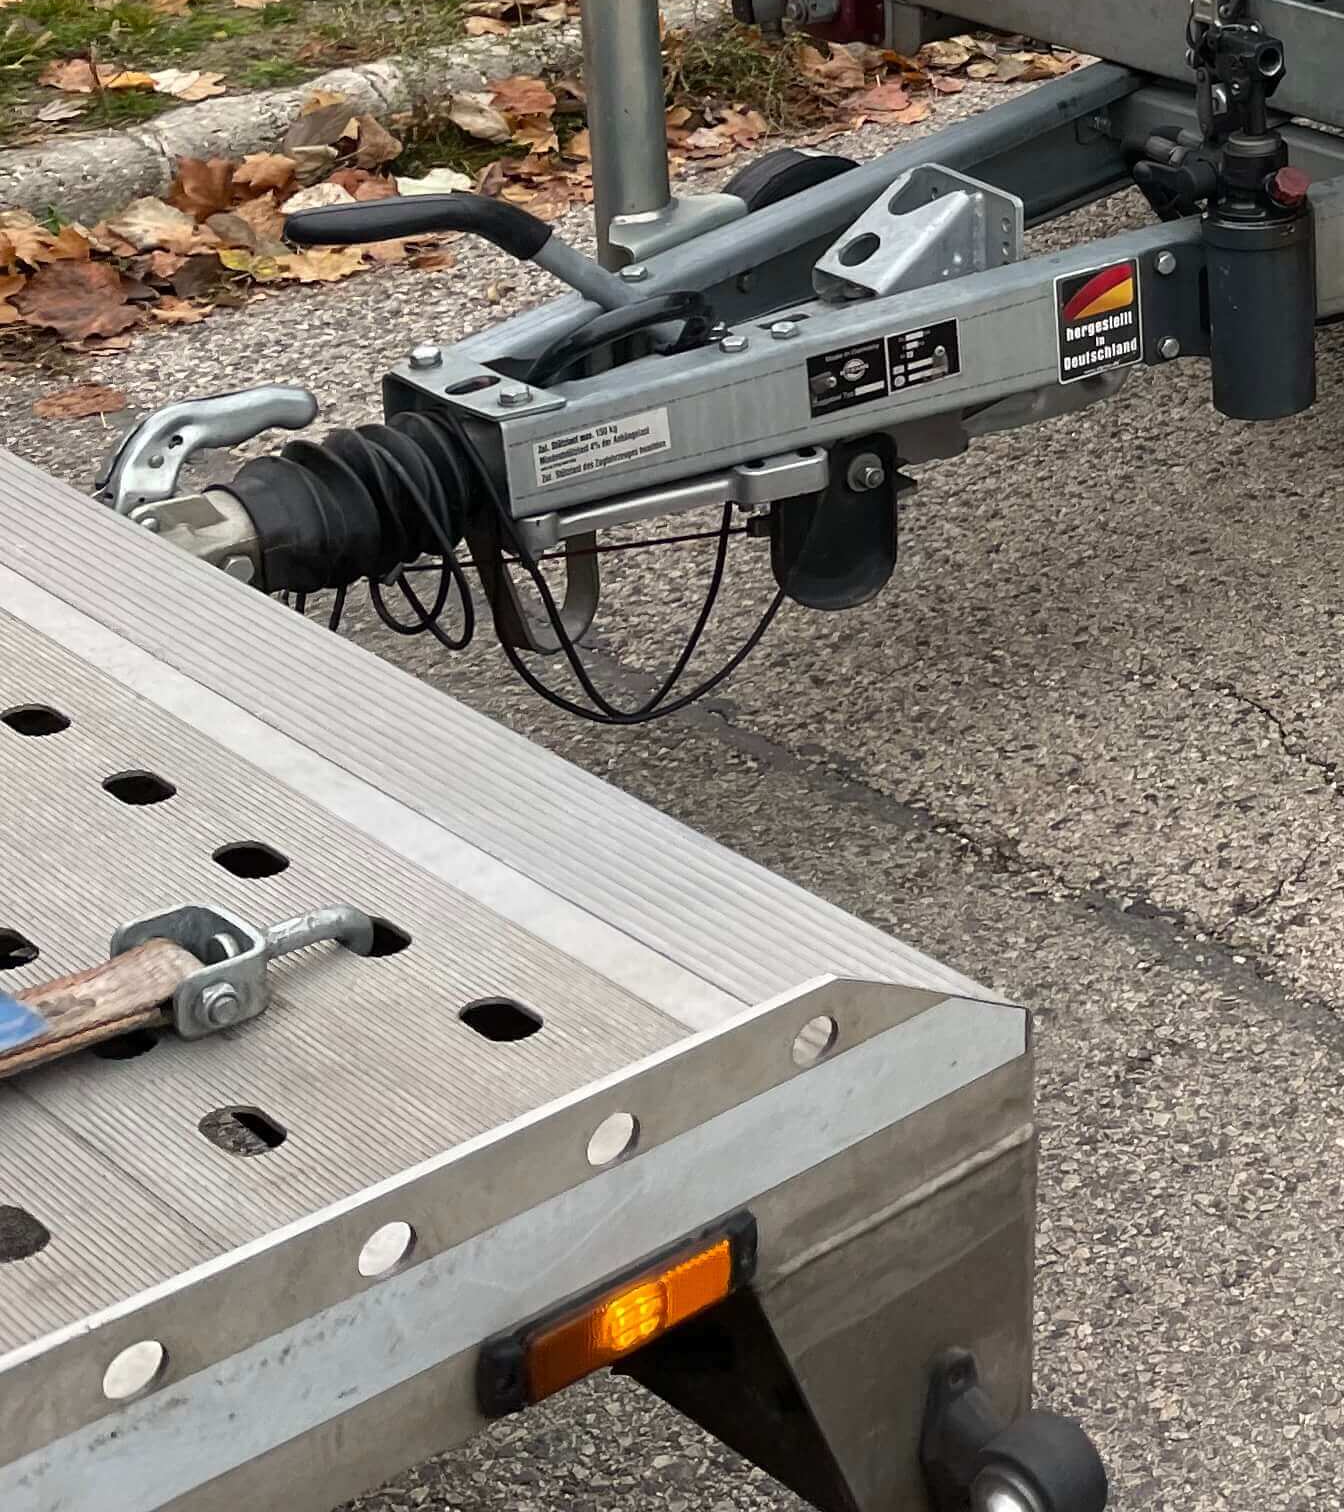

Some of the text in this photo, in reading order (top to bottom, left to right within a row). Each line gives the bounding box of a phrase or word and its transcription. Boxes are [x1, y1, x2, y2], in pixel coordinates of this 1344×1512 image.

[1066, 311, 1133, 342] hergestellt
[1095, 336, 1105, 347] in
[1063, 337, 1137, 371] Deutschland
